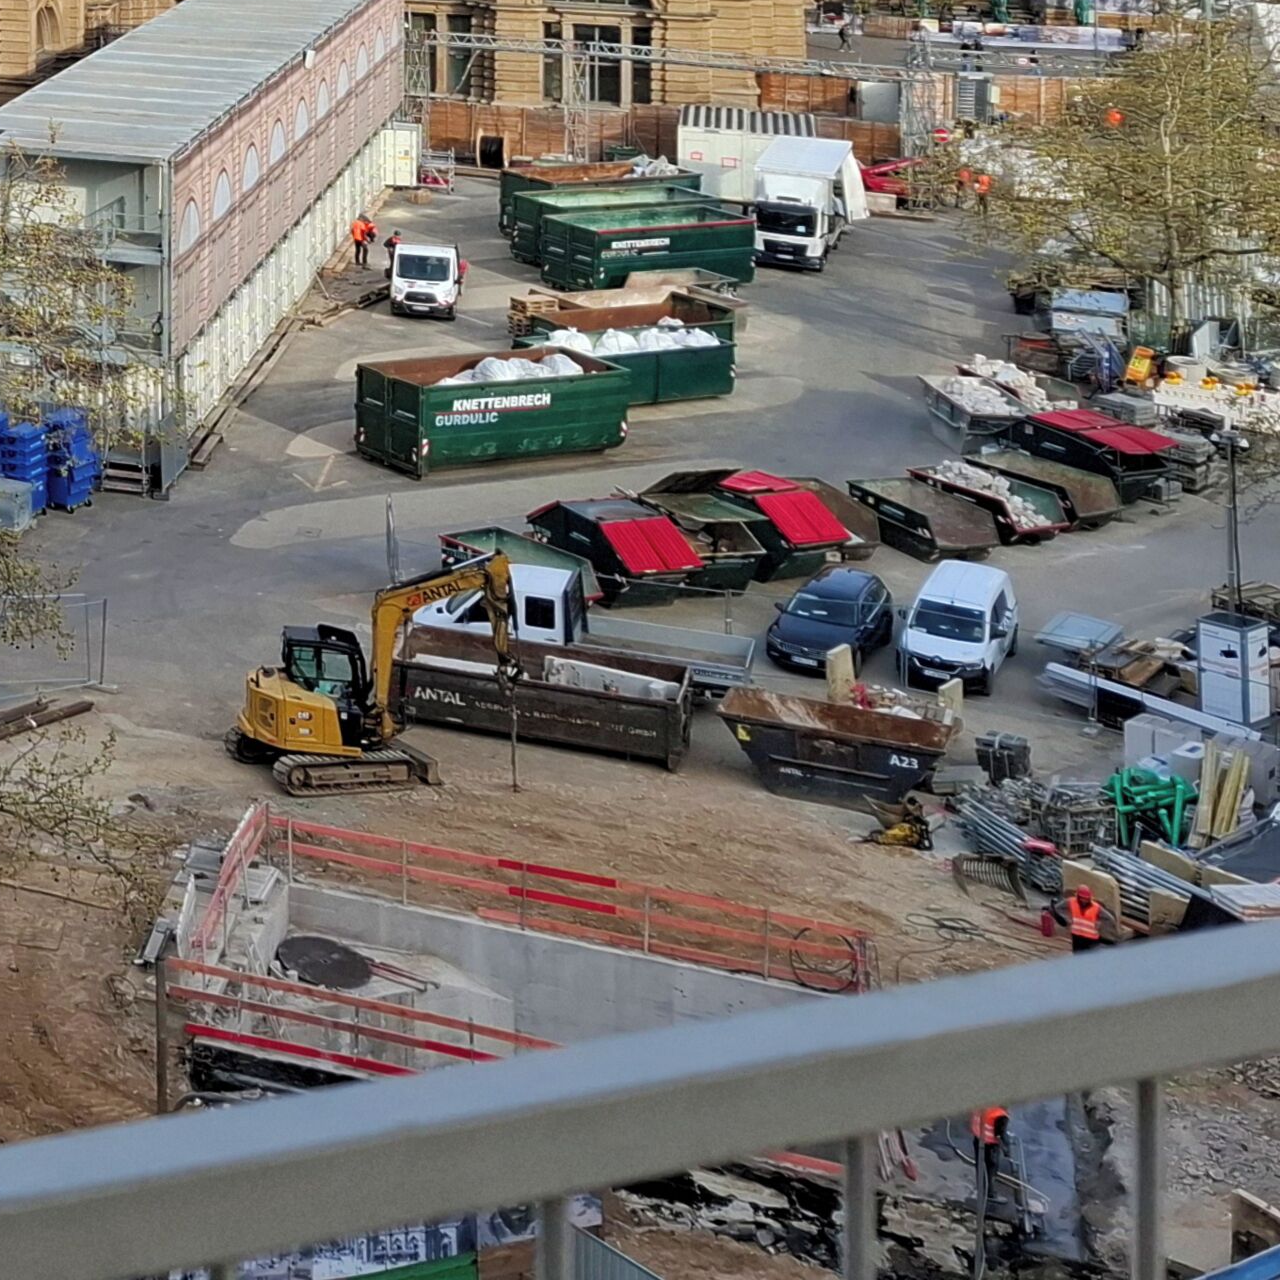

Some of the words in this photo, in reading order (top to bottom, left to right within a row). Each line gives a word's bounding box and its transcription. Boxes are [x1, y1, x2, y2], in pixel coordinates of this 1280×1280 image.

[452, 392, 552, 412] KNETTENBRECH
[435, 412, 499, 427] GURDULIC
[422, 580, 462, 604] ANTAL
[414, 685, 467, 707] ANTAL
[889, 754, 919, 769] A23
